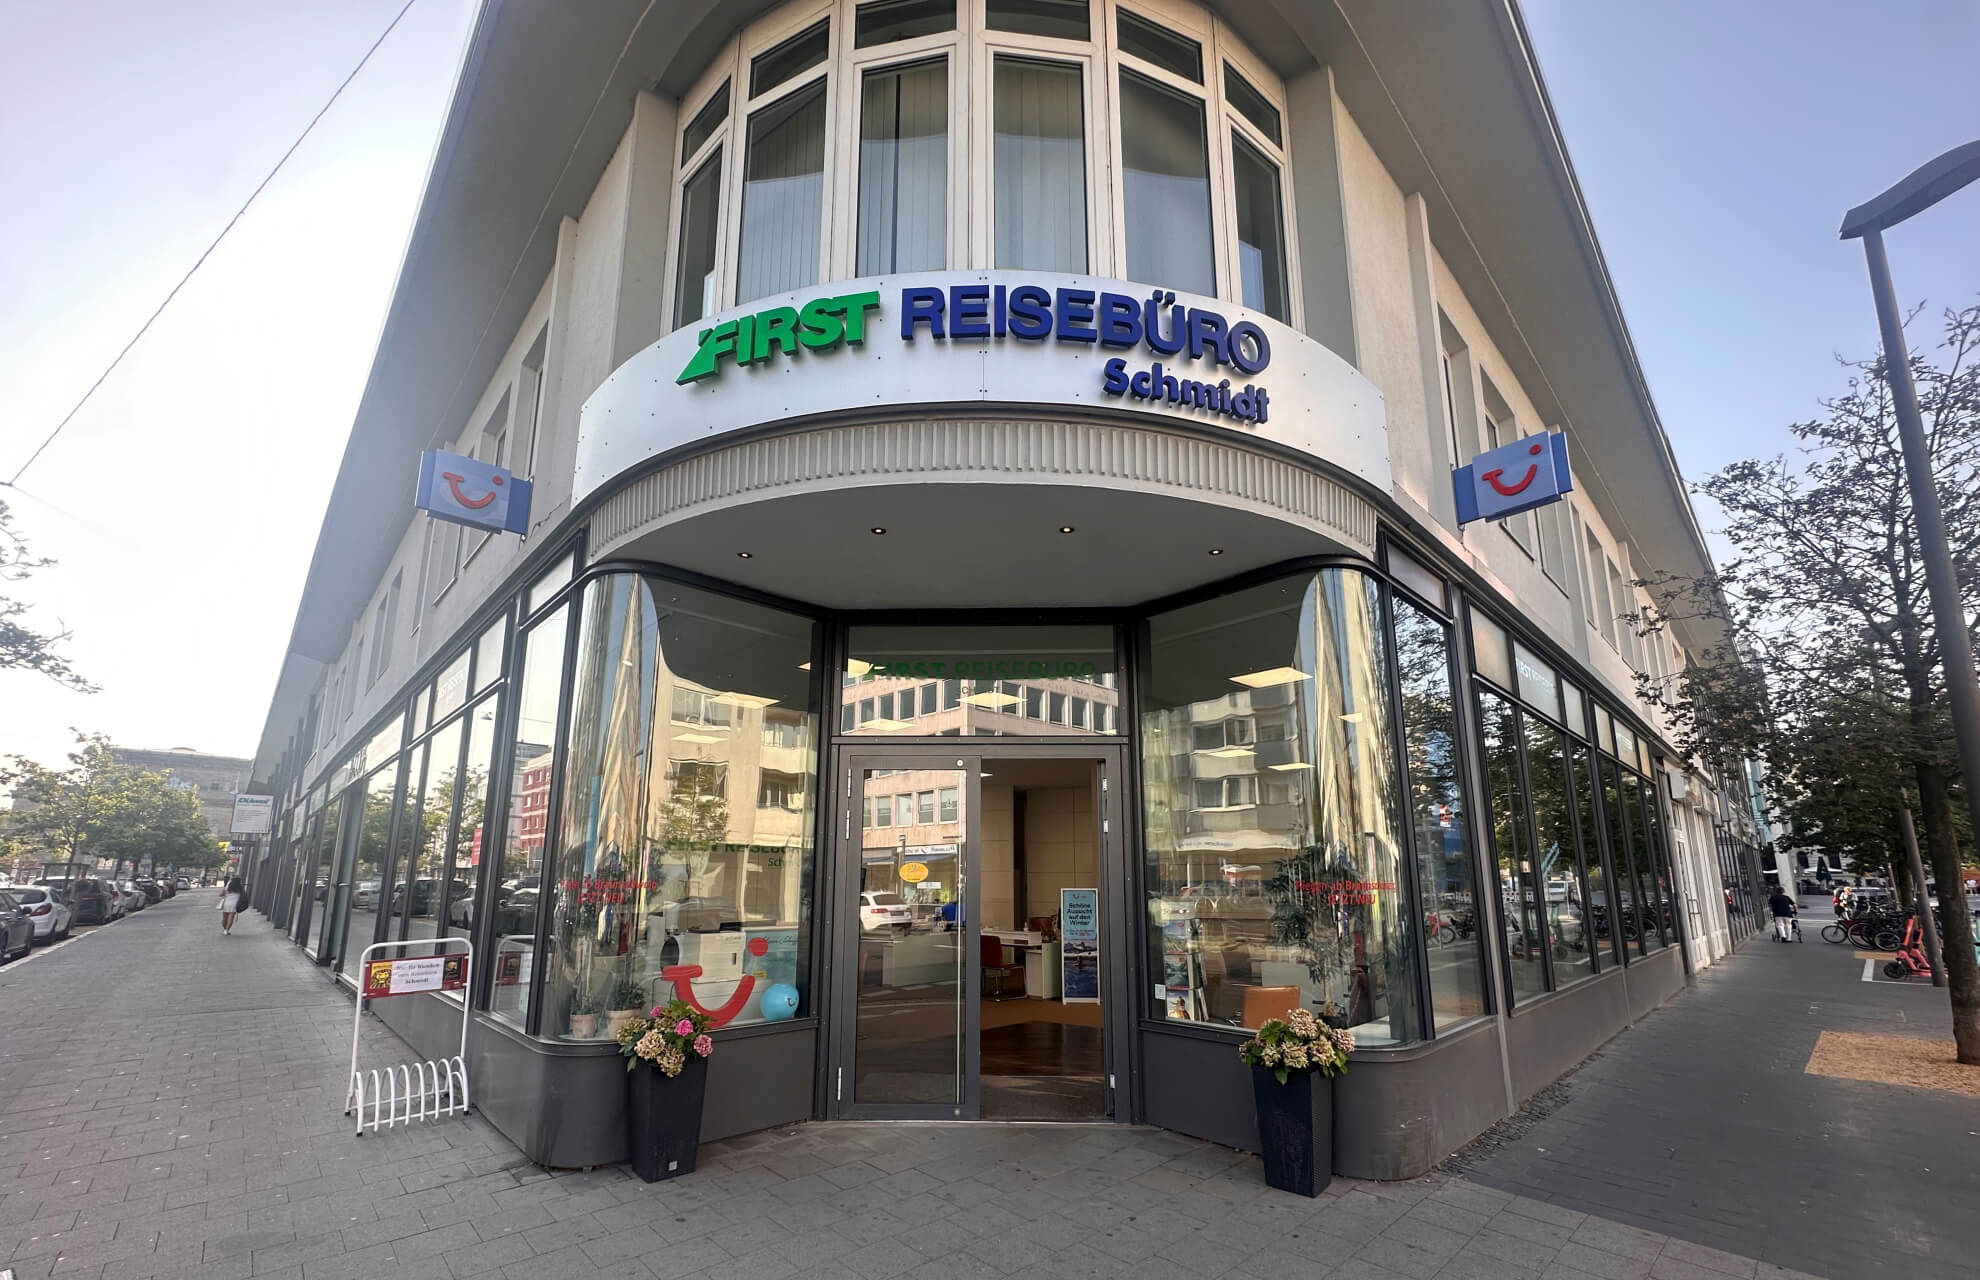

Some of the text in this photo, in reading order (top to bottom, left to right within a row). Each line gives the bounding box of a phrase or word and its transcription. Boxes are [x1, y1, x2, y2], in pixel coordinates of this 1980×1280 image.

[675, 284, 1271, 386] FIRST REISEBÜRO
[1103, 357, 1270, 424] Schmidt
